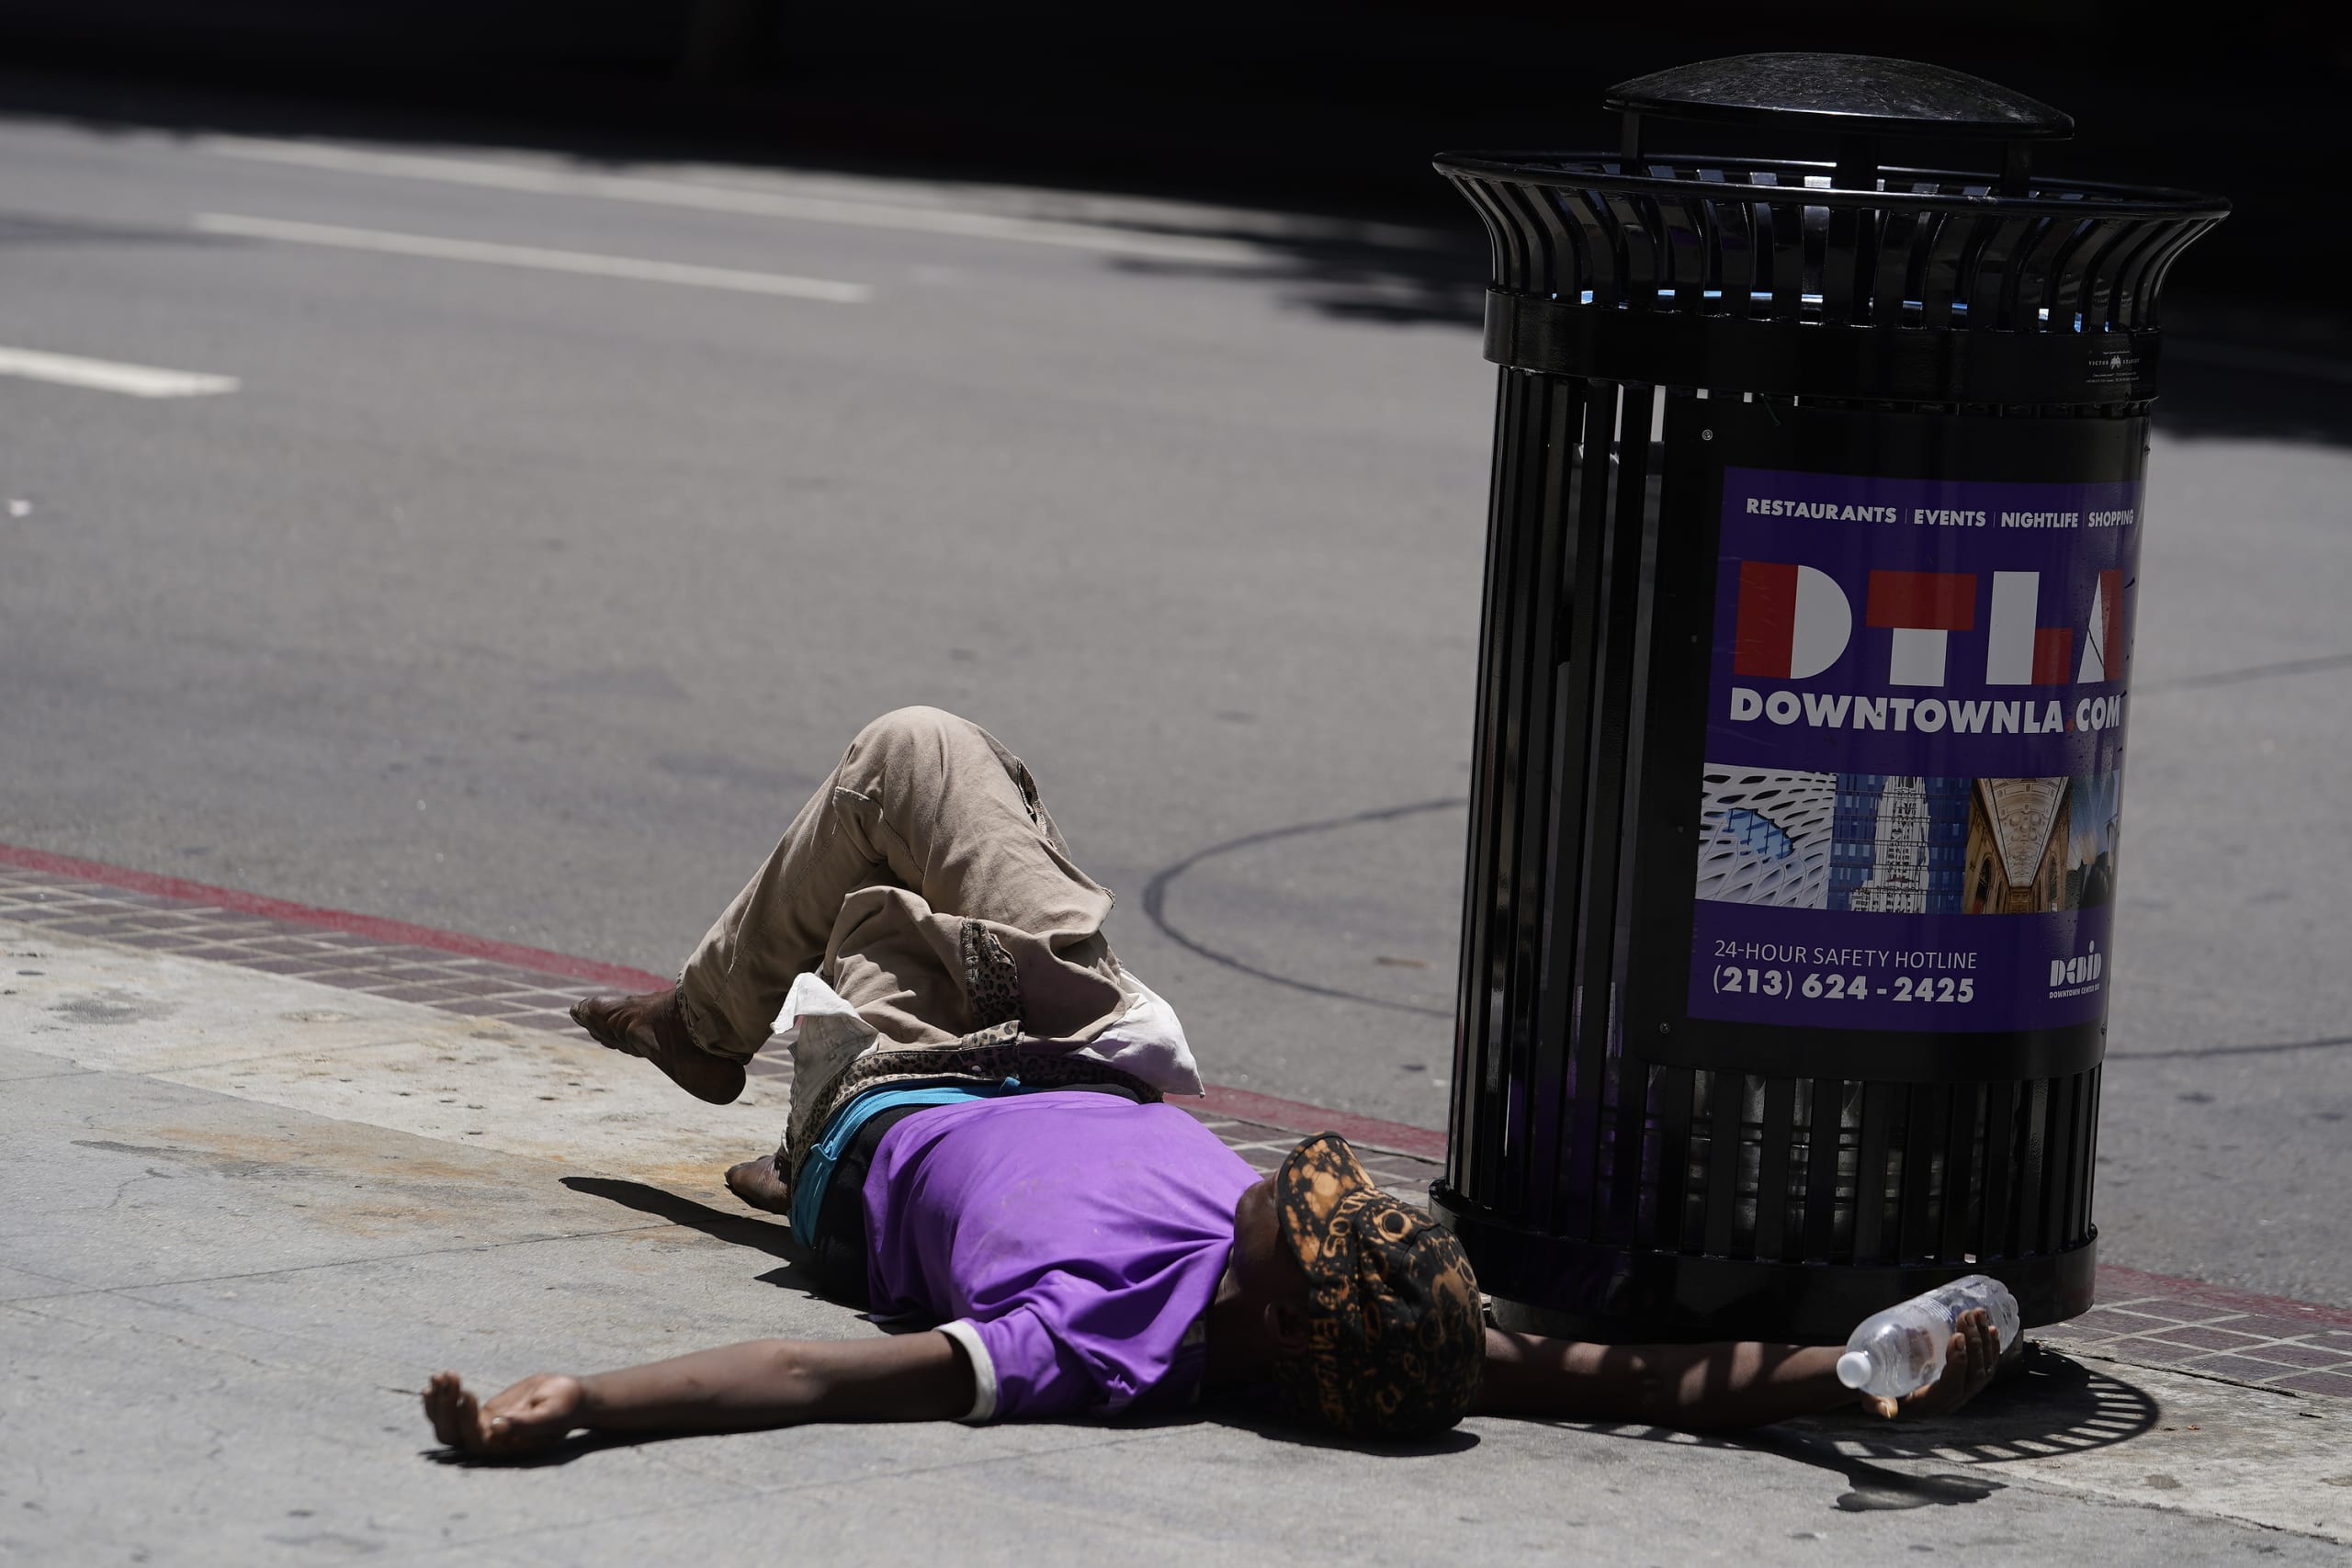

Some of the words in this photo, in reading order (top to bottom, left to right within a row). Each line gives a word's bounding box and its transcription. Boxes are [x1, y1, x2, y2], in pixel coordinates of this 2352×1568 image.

[1746, 498, 1897, 524] RESTAURANTS
[1914, 509, 1986, 527] EVENTS
[2001, 512, 2079, 528] NIGHTLIFE
[2087, 509, 2134, 528] SHOPPING
[1734, 560, 2122, 687] DTLA
[1730, 687, 2121, 734] DOWNTOWNLA.COM
[1714, 940, 1807, 964] 24-HOUR
[1813, 946, 1890, 968] SAFETY
[1894, 951, 1978, 969] HOTLINE
[1713, 964, 1793, 999] (213)
[2049, 987, 2081, 999] DOWNTOWN
